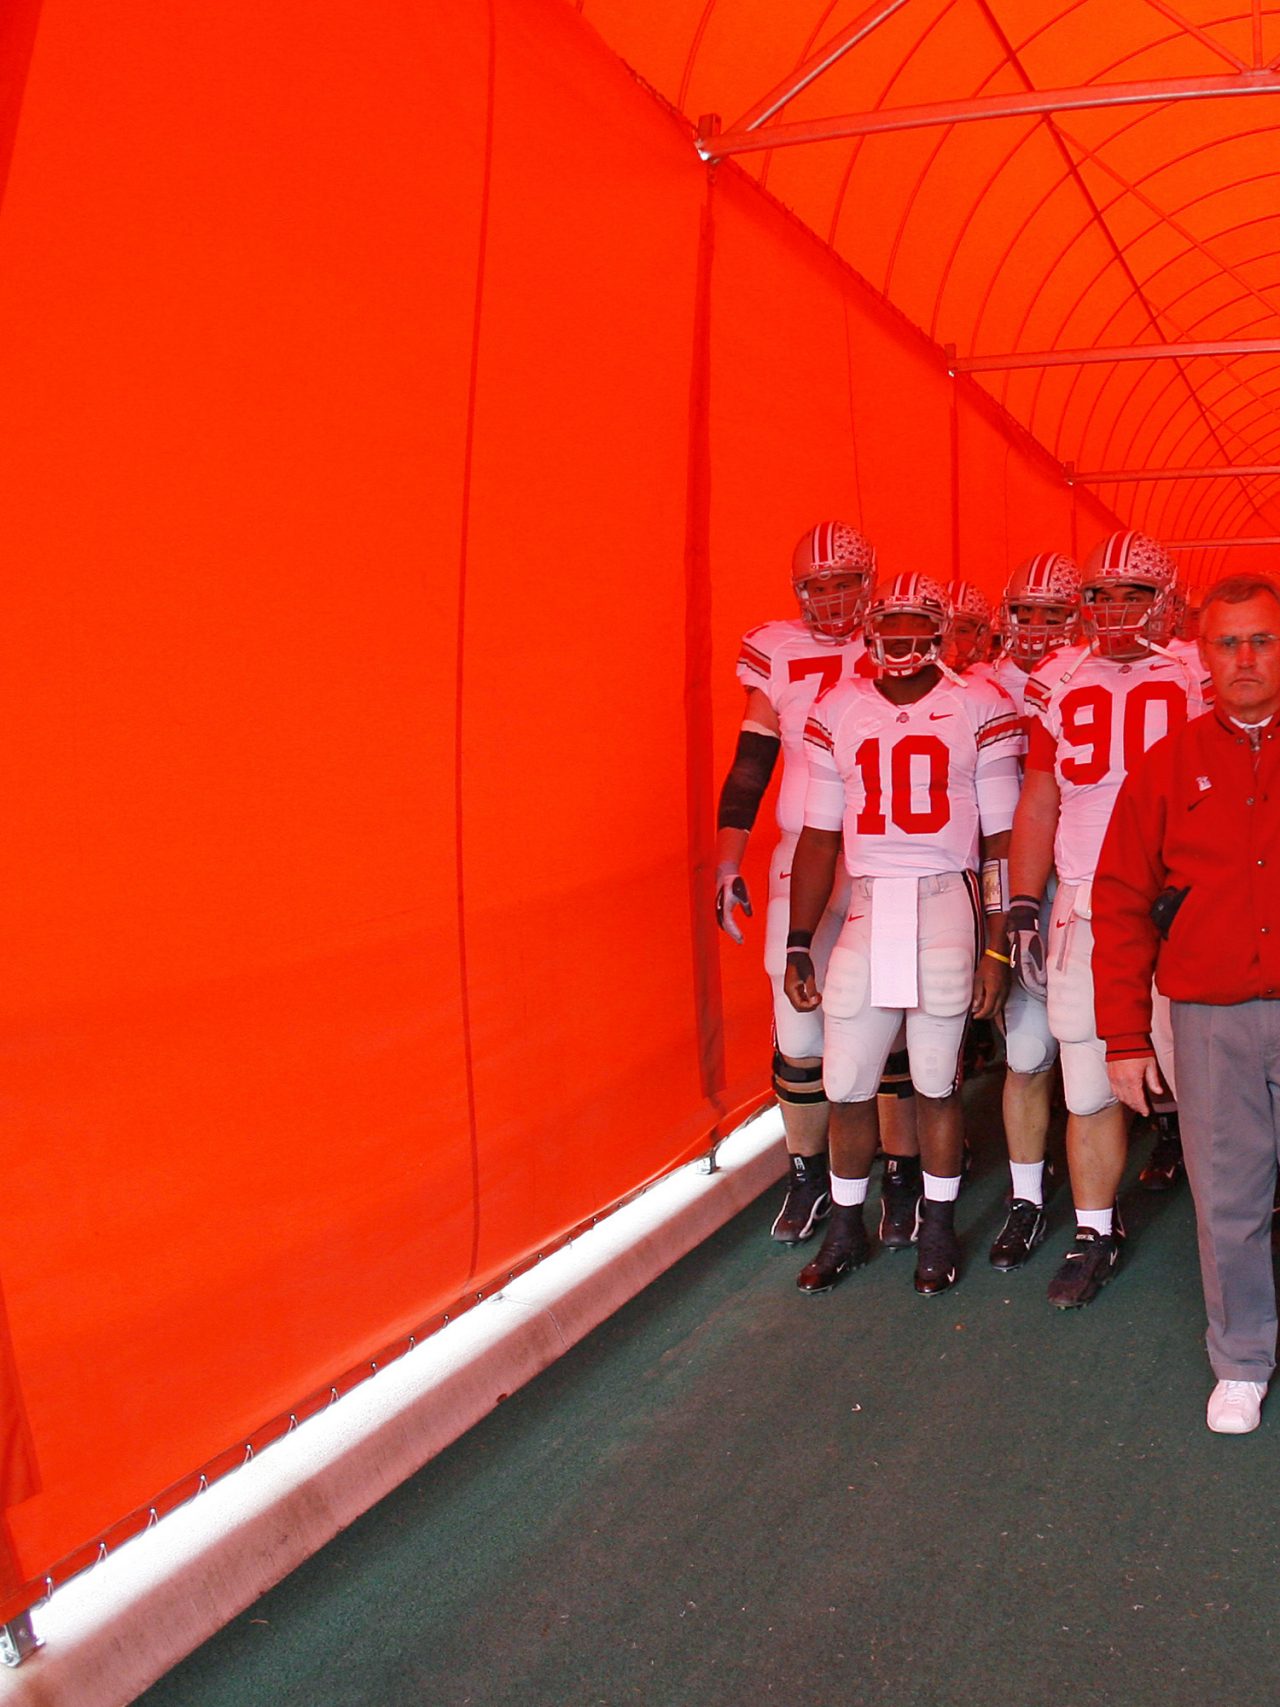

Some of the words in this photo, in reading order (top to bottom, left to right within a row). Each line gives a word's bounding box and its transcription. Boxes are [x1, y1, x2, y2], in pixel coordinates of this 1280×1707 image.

[788, 654, 878, 698] 7
[1059, 681, 1187, 785] 90
[855, 735, 950, 834] 10
